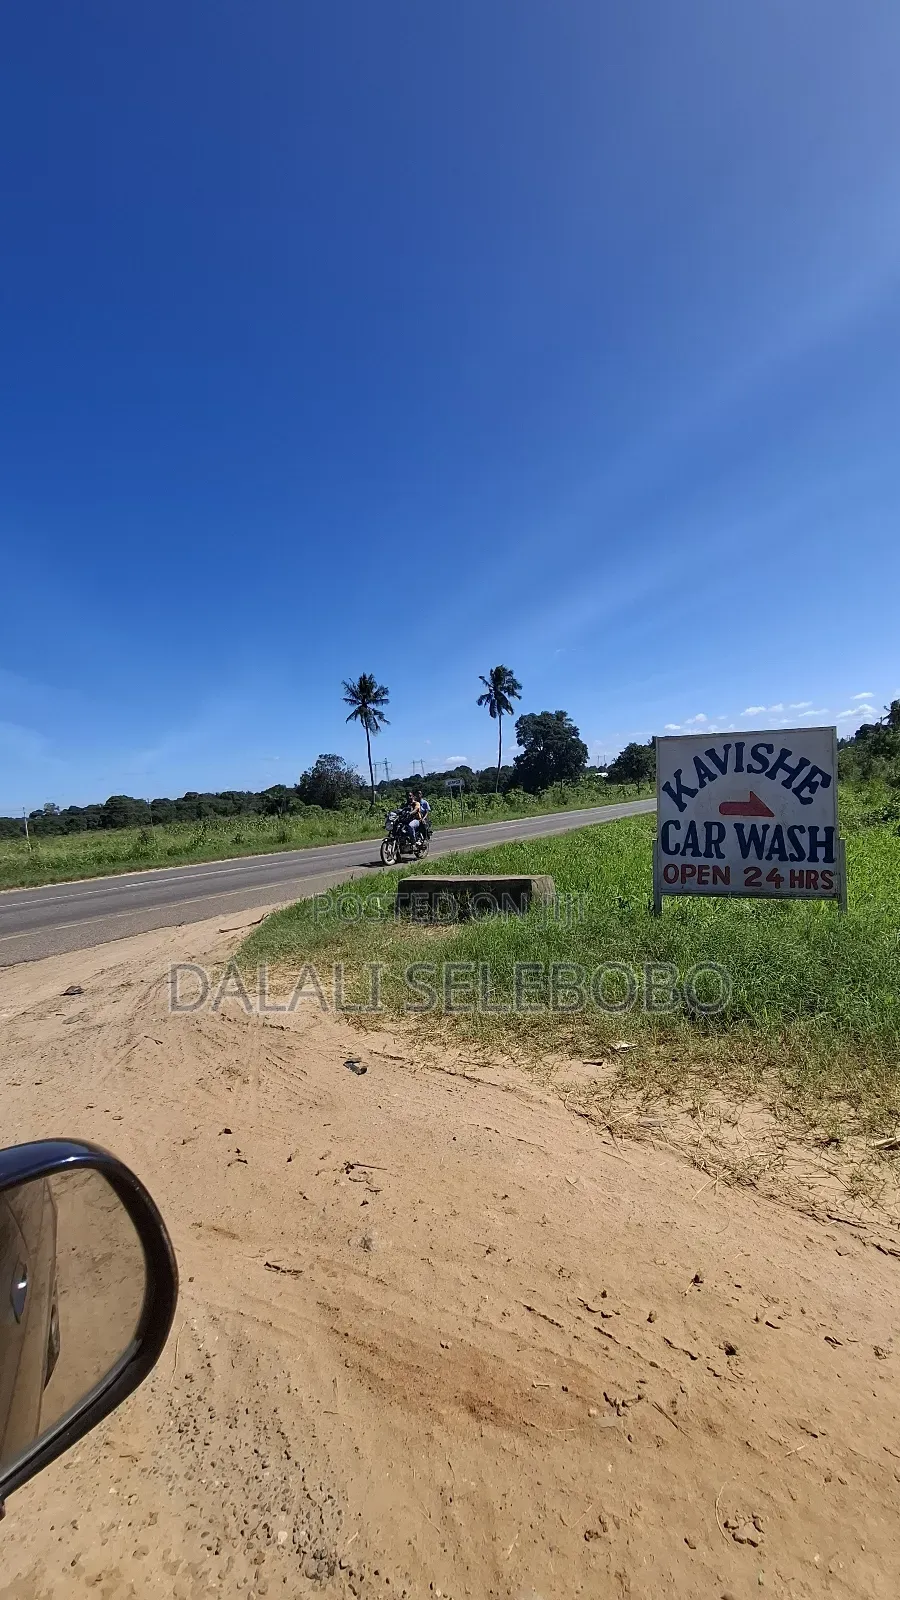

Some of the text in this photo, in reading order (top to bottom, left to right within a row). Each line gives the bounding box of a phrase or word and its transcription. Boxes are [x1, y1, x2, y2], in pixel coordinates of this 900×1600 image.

[662, 741, 832, 812] KAVISHE
[661, 819, 835, 863] CAR WASH
[663, 863, 834, 890] OPEN 24 HRS
